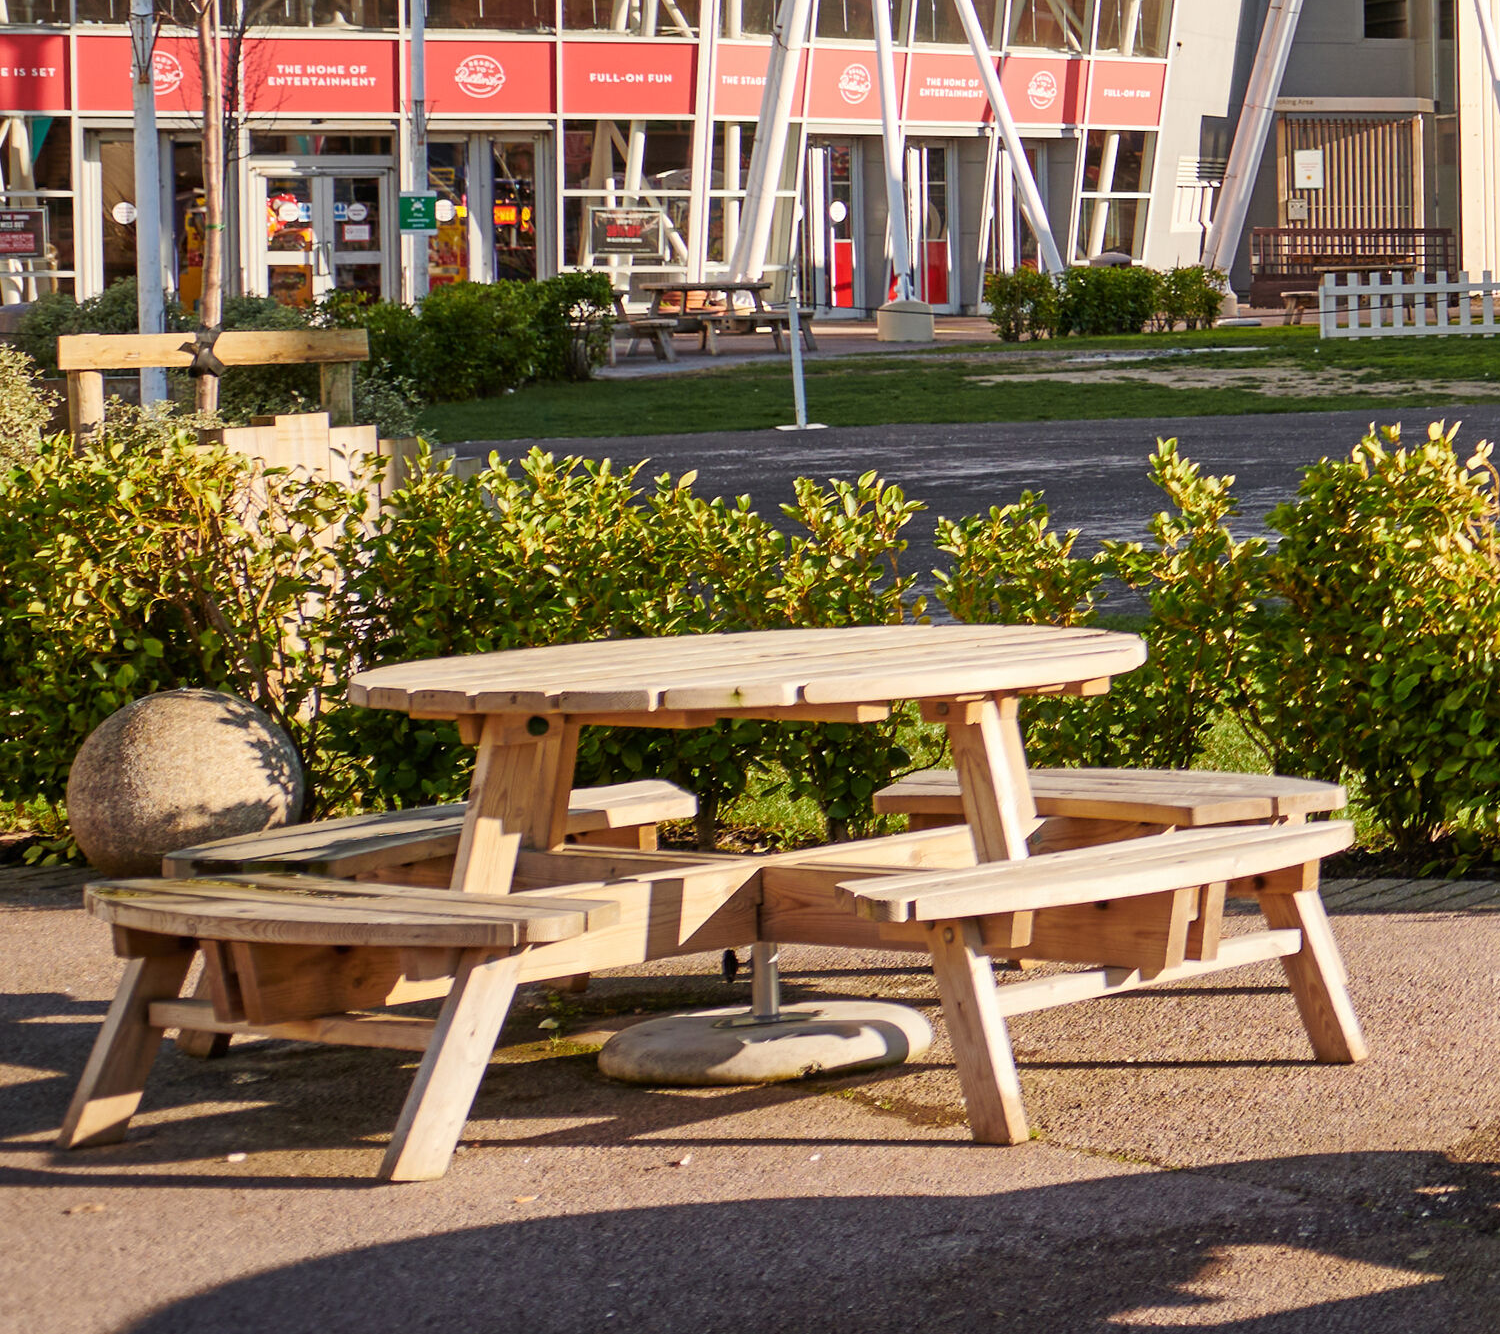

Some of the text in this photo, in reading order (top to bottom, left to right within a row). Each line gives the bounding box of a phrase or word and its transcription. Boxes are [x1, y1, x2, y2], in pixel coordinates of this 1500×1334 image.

[14, 67, 26, 77] IS
[31, 67, 57, 77] SET
[276, 64, 368, 75] THE HOME OF
[267, 76, 377, 87] ENTERTAINMENT
[589, 72, 673, 84] FULL-ON FUN
[721, 75, 739, 85] THE
[926, 77, 979, 88] THE HOME OF
[919, 87, 984, 98] ENTERTAINMENT
[1103, 88, 1151, 98] FULL-ON FUN
